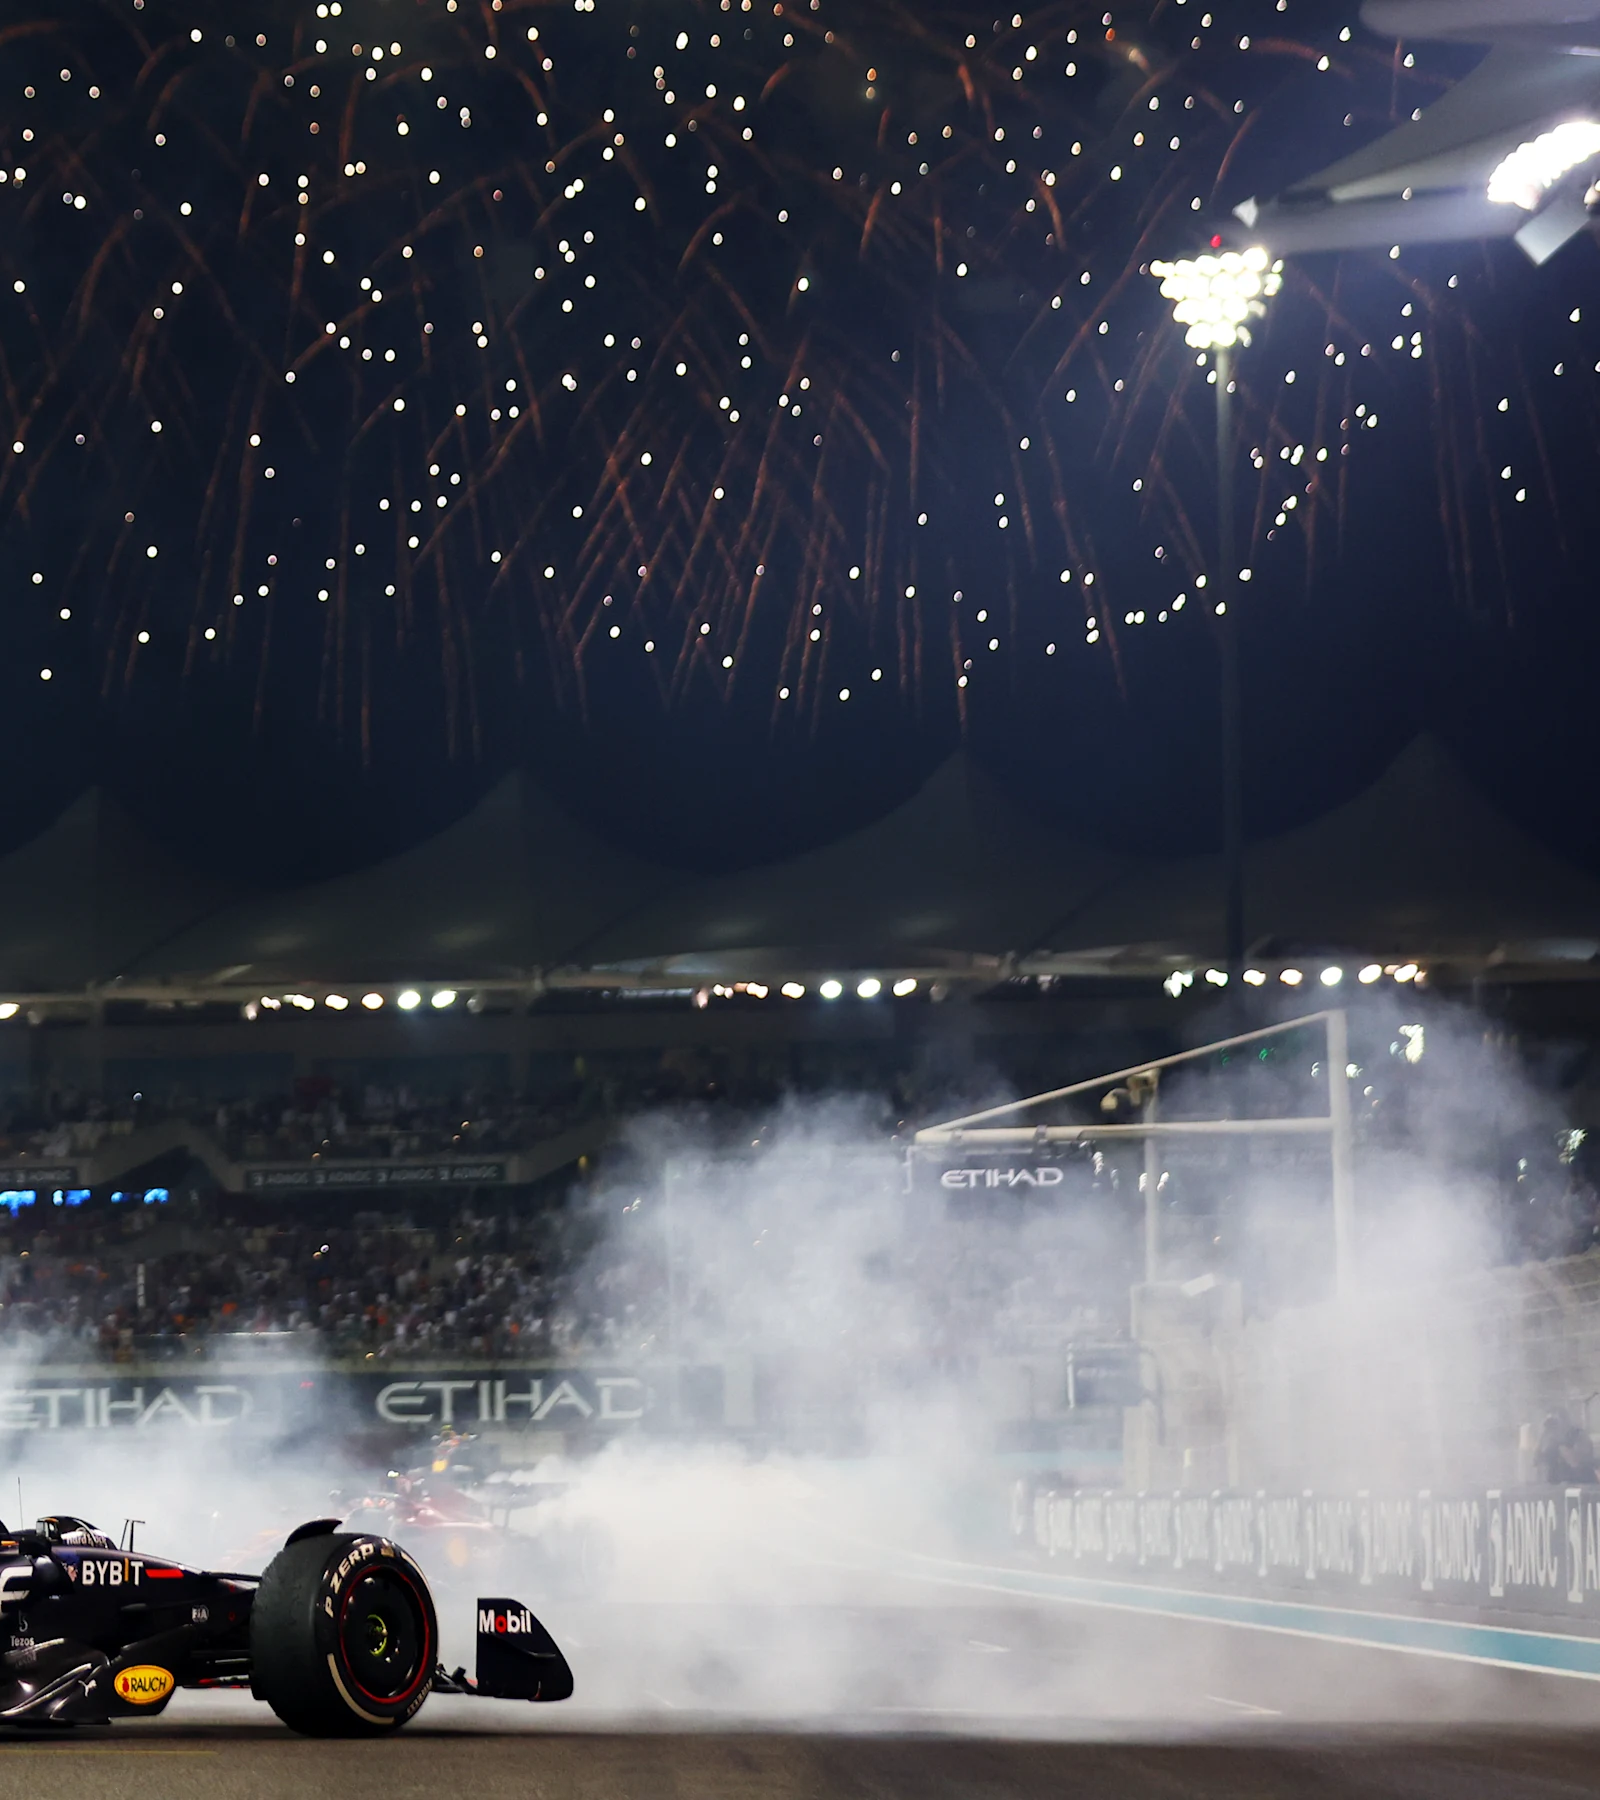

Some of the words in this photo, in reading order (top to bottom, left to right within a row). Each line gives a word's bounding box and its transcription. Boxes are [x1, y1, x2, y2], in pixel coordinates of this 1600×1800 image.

[940, 1167, 1064, 1189] ETIHAD
[376, 1377, 658, 1423] ETIHAD
[1505, 1499, 1558, 1587] ADNOC
[82, 1557, 144, 1586] BYBIT
[324, 1596, 334, 1618] P
[330, 1543, 375, 1594] ZERO
[479, 1609, 532, 1634] Mobil
[10, 1635, 35, 1647] Tezos
[130, 1678, 166, 1692] RAUCH
